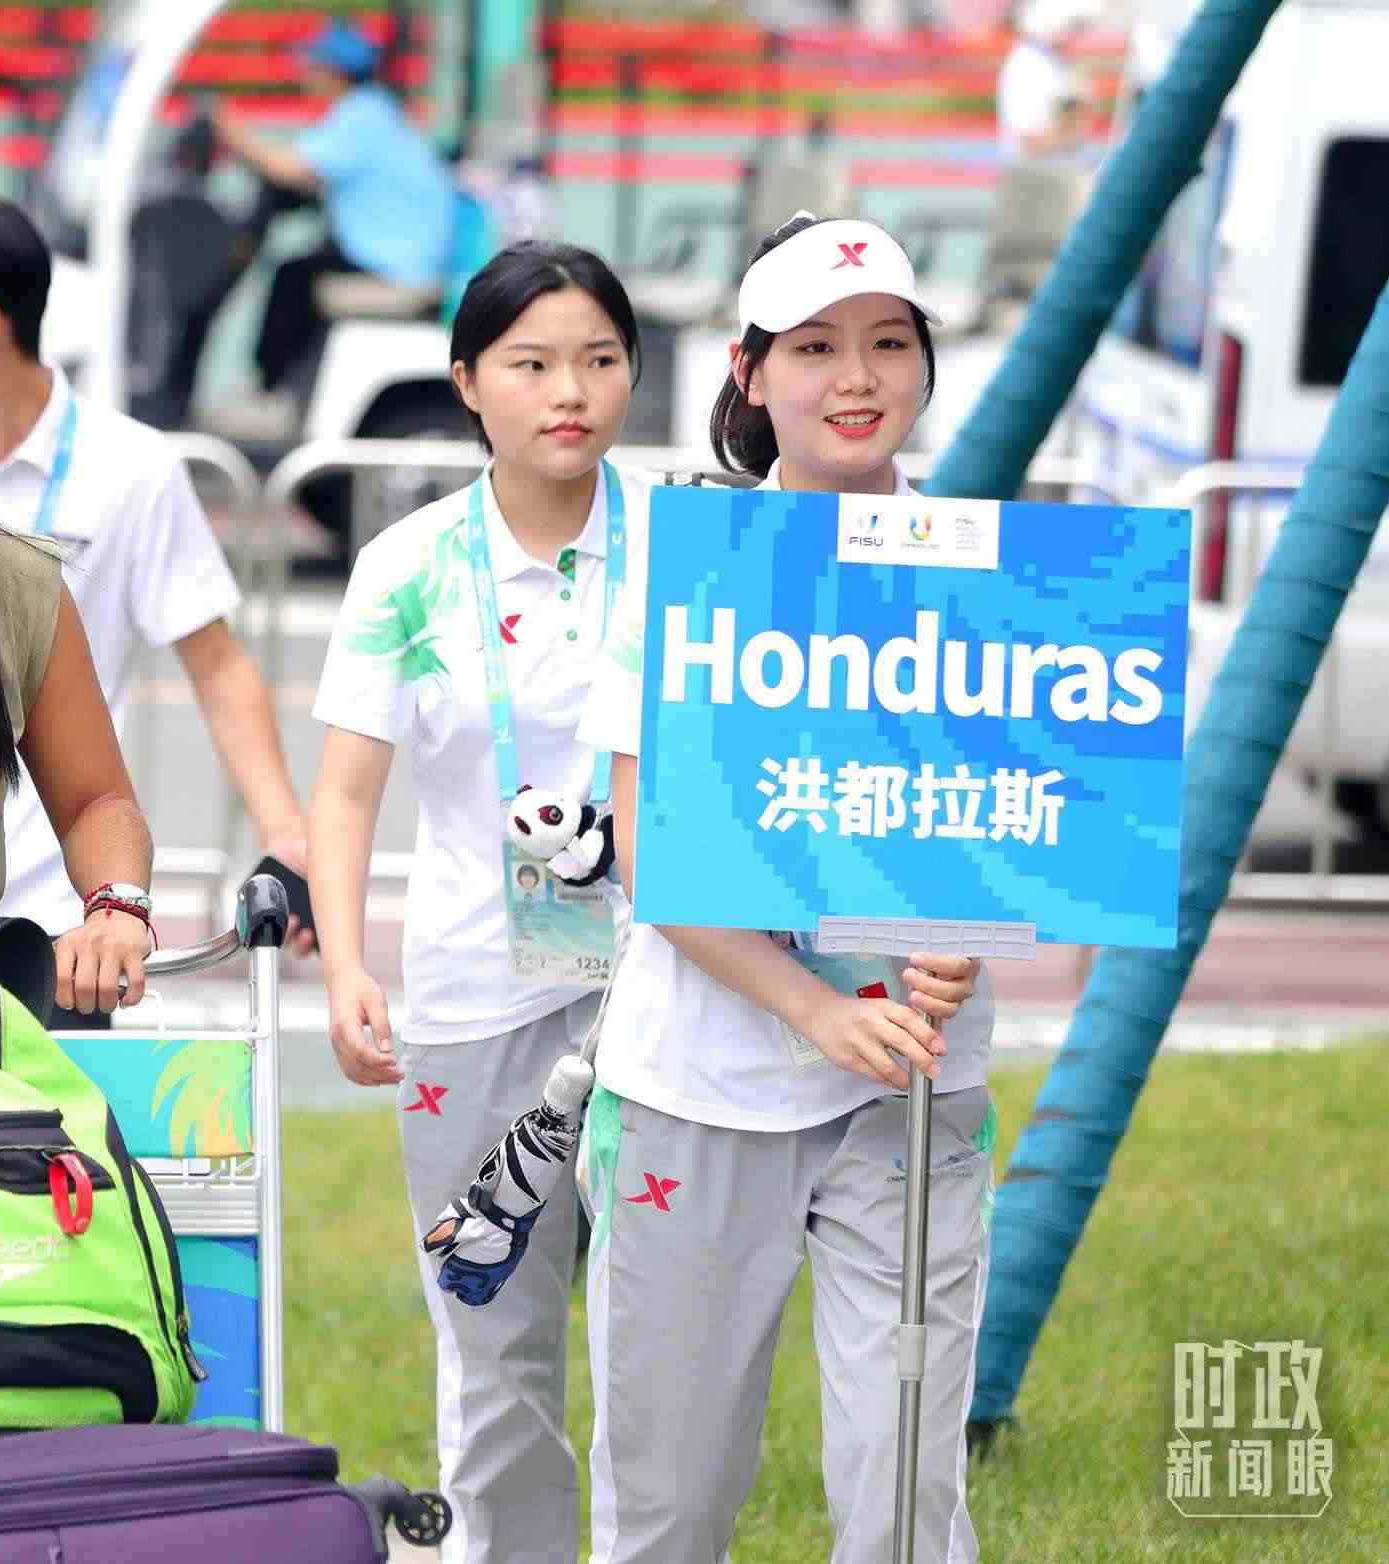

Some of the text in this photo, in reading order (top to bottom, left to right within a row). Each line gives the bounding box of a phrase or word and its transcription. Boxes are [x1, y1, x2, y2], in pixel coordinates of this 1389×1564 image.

[848, 536, 884, 547] FISU
[661, 603, 1163, 725] Honduras
[755, 756, 1067, 847] 洪都拉斯
